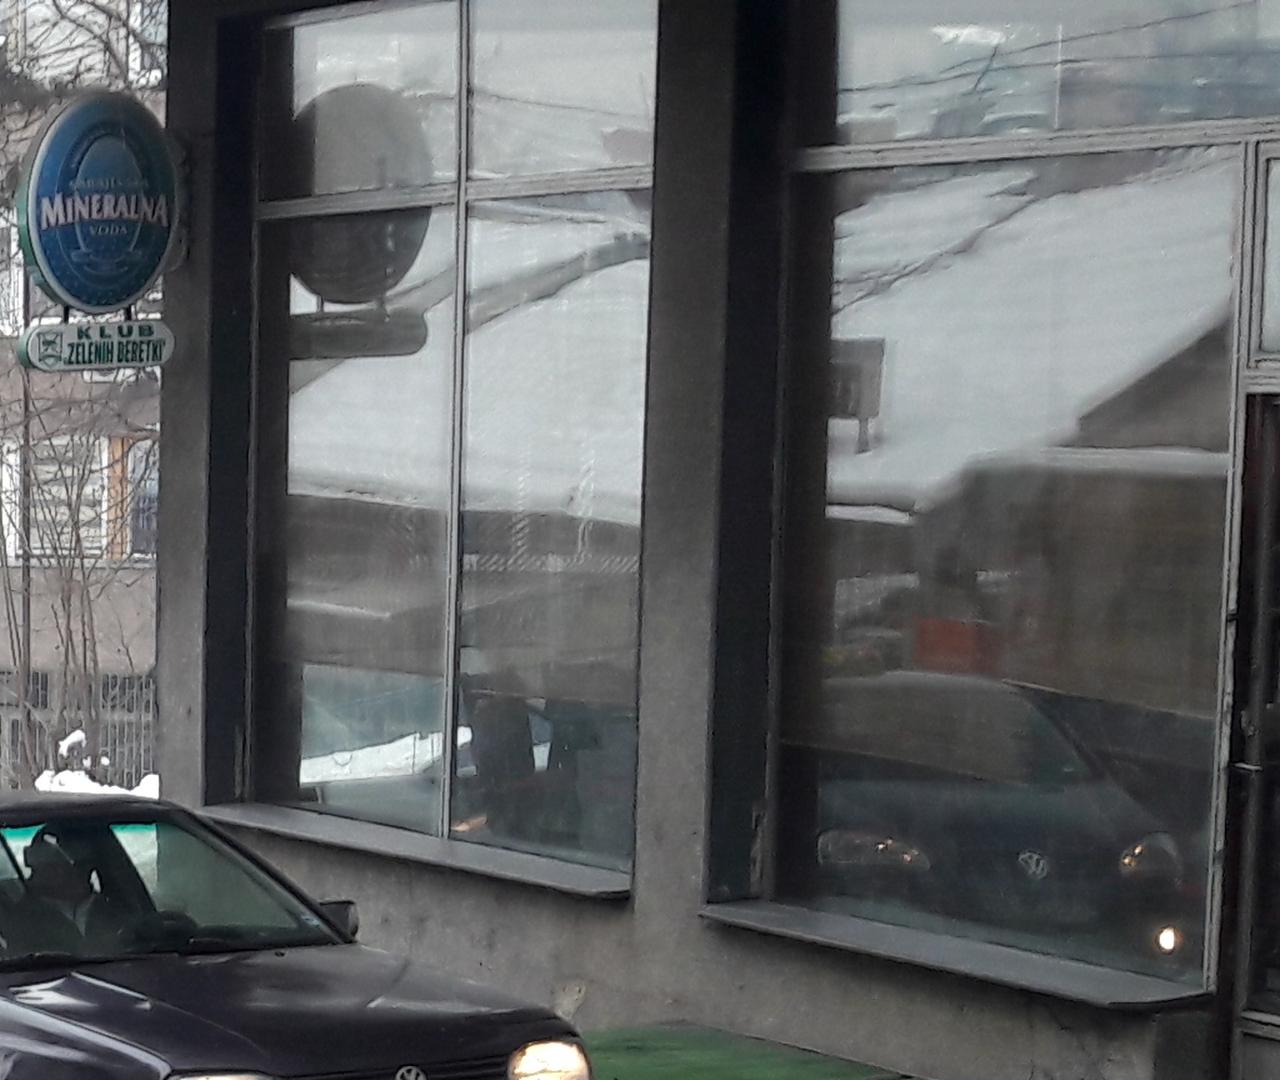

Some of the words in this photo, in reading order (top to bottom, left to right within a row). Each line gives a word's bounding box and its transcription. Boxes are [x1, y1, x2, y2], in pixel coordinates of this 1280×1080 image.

[40, 192, 169, 231] MINERALNA
[88, 223, 128, 236] VODA
[77, 325, 154, 339] KLUB
